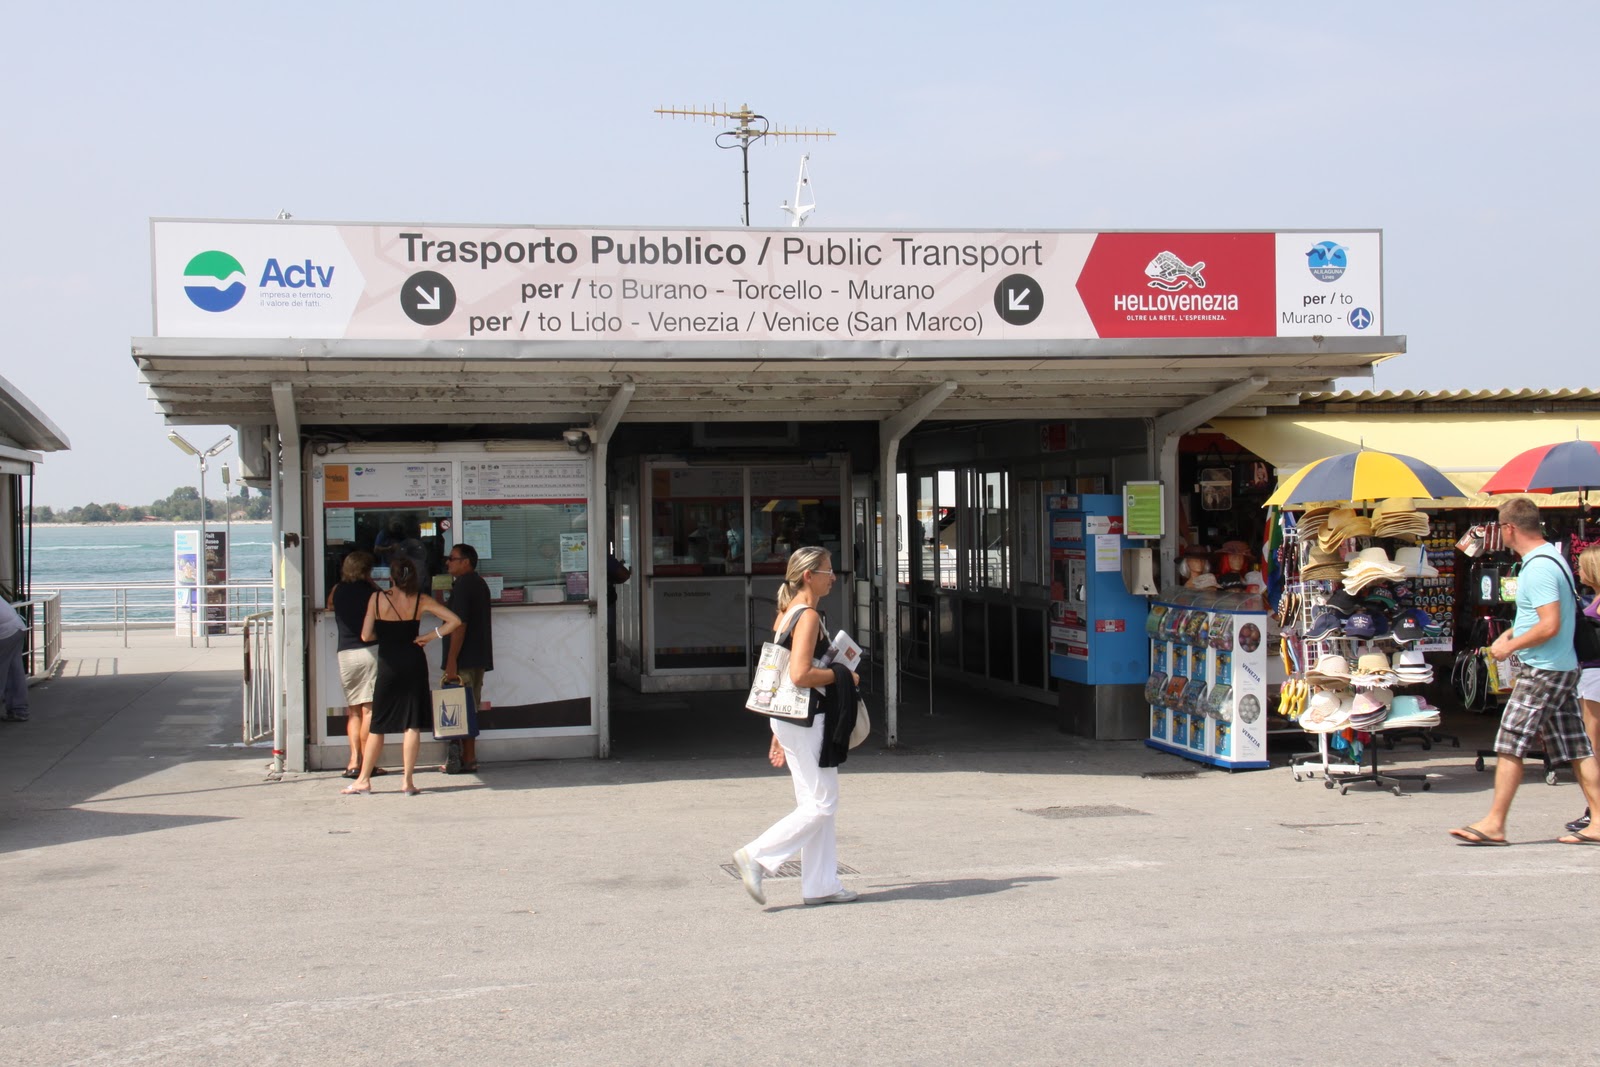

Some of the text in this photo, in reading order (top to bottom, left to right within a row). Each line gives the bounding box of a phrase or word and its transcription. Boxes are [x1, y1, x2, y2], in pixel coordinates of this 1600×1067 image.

[399, 233, 1043, 274] Trasporto Pubblico / Public Transport
[259, 258, 335, 289] Actv
[259, 291, 290, 300] impresa
[299, 291, 333, 300] territorio,
[521, 283, 564, 304] per
[571, 279, 582, 300] /
[588, 279, 613, 300] to
[622, 278, 707, 300] Burano
[733, 279, 823, 300] Torcello
[848, 279, 935, 300] Murano
[1303, 292, 1353, 308] per / to
[469, 315, 513, 336] per
[519, 311, 530, 333] /
[537, 312, 562, 333] to
[571, 311, 622, 333] Lido
[649, 311, 739, 333] Venezia
[746, 312, 756, 333] /
[762, 311, 840, 333] Venice
[847, 312, 897, 337] (San
[906, 312, 983, 337] Marco)
[1159, 314, 1178, 322] RETE,
[1282, 311, 1333, 324] Murano
[1242, 663, 1261, 683] VENEZIA
[1242, 728, 1261, 748] VENEZIA
